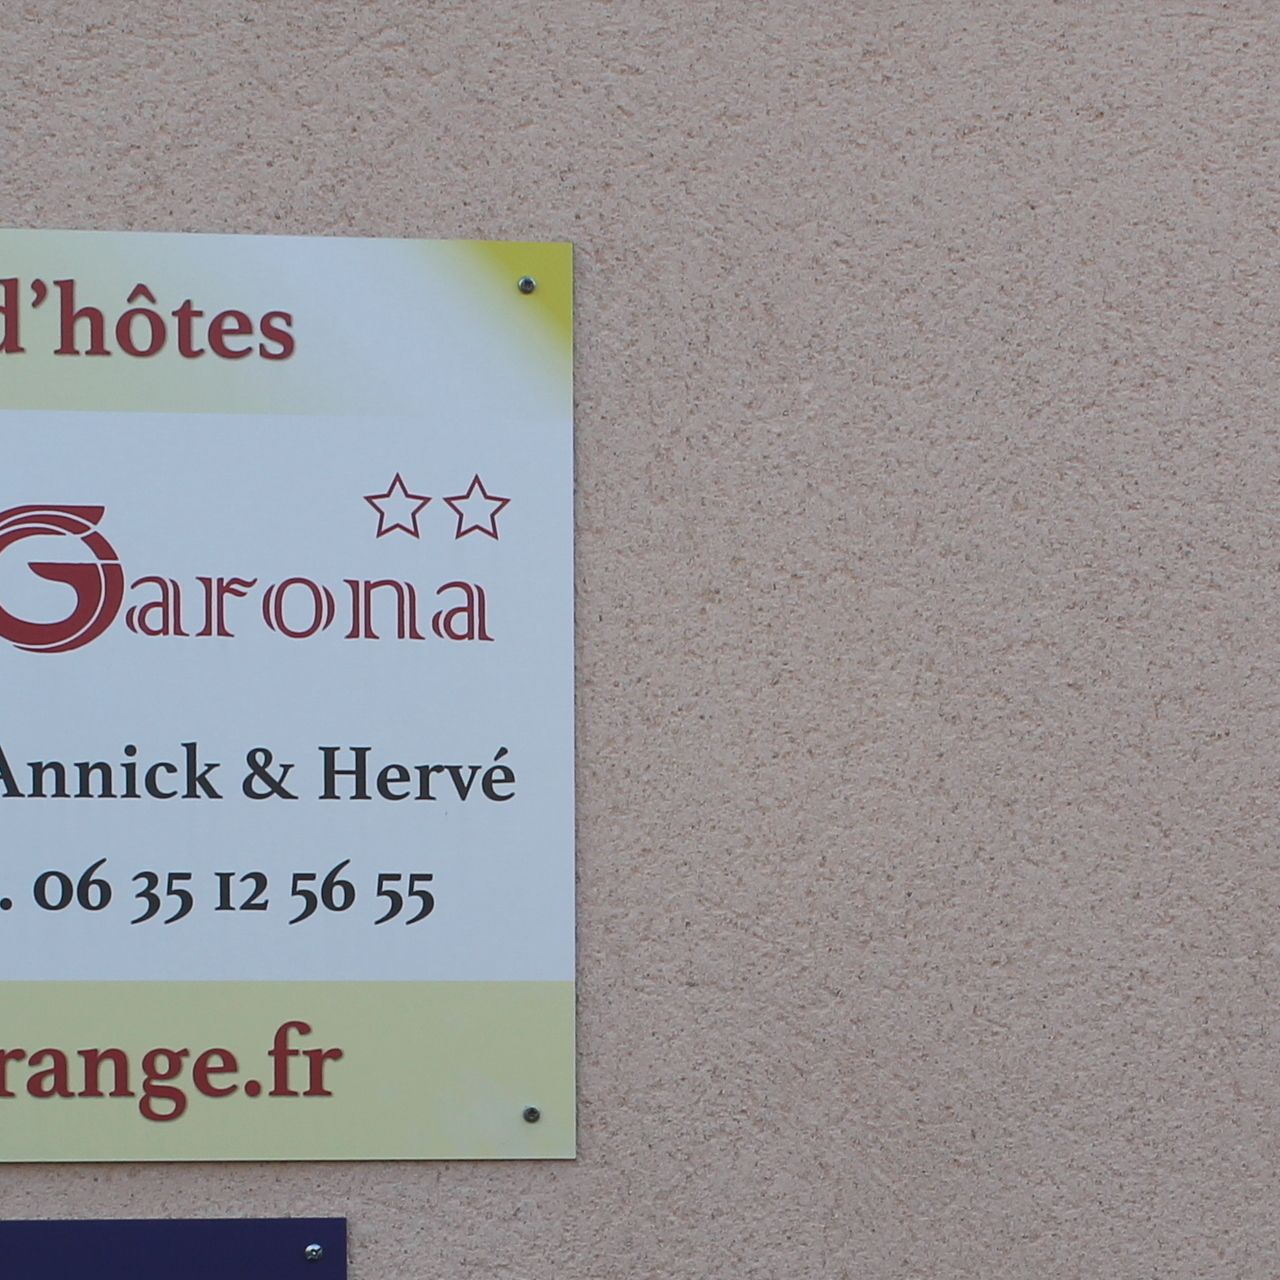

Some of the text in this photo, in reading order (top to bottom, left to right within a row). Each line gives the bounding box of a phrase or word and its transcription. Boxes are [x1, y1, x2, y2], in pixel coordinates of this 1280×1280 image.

[241, 747, 299, 800] &
[318, 746, 517, 802] Hervé
[32, 857, 113, 912] 06
[131, 870, 195, 925] 35
[214, 870, 270, 911] 12
[289, 859, 357, 925] 56
[374, 870, 435, 925] 55
